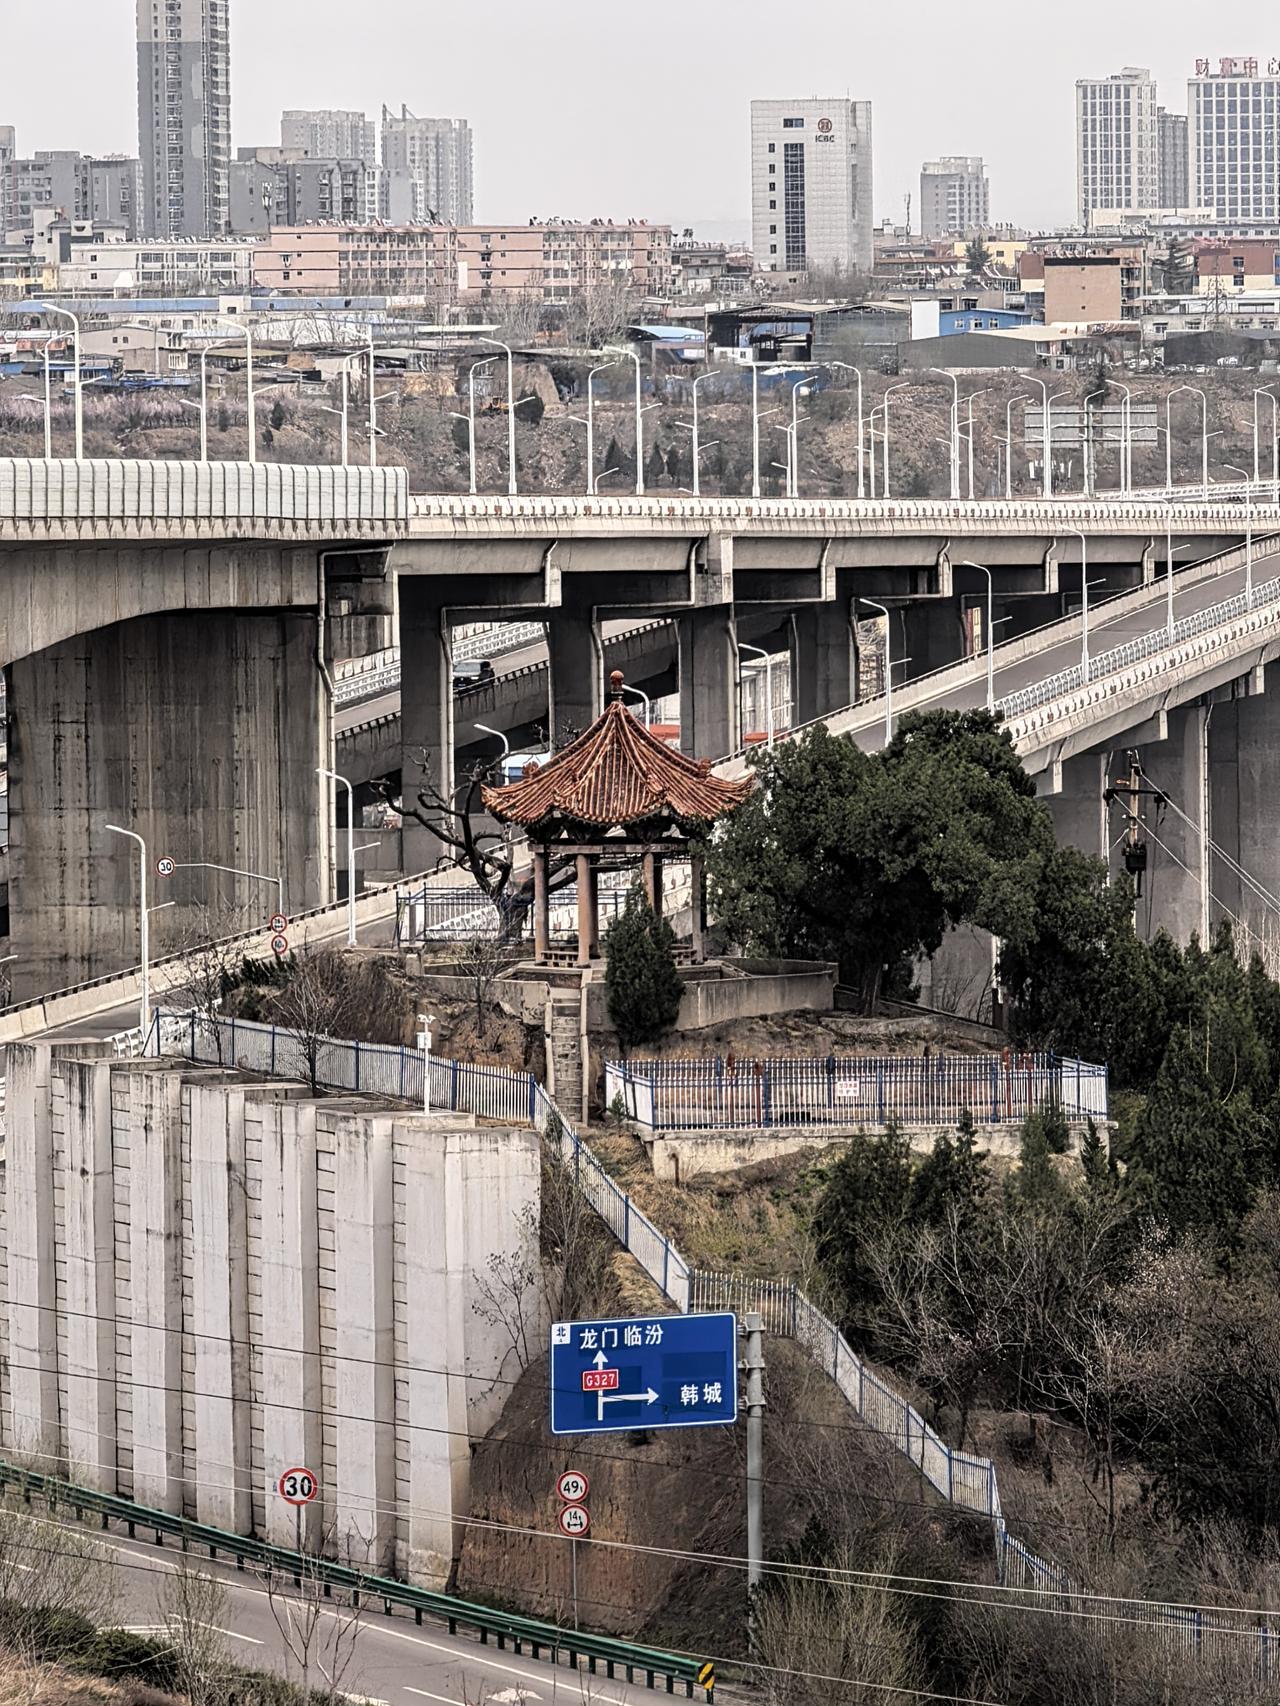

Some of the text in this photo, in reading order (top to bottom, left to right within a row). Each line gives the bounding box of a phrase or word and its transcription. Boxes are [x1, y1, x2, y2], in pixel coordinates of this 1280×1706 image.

[160, 862, 172, 872] 30
[556, 1326, 566, 1337] 北
[586, 1373, 615, 1387] G327
[680, 1382, 722, 1406] 韩城
[286, 1475, 312, 1497] 30
